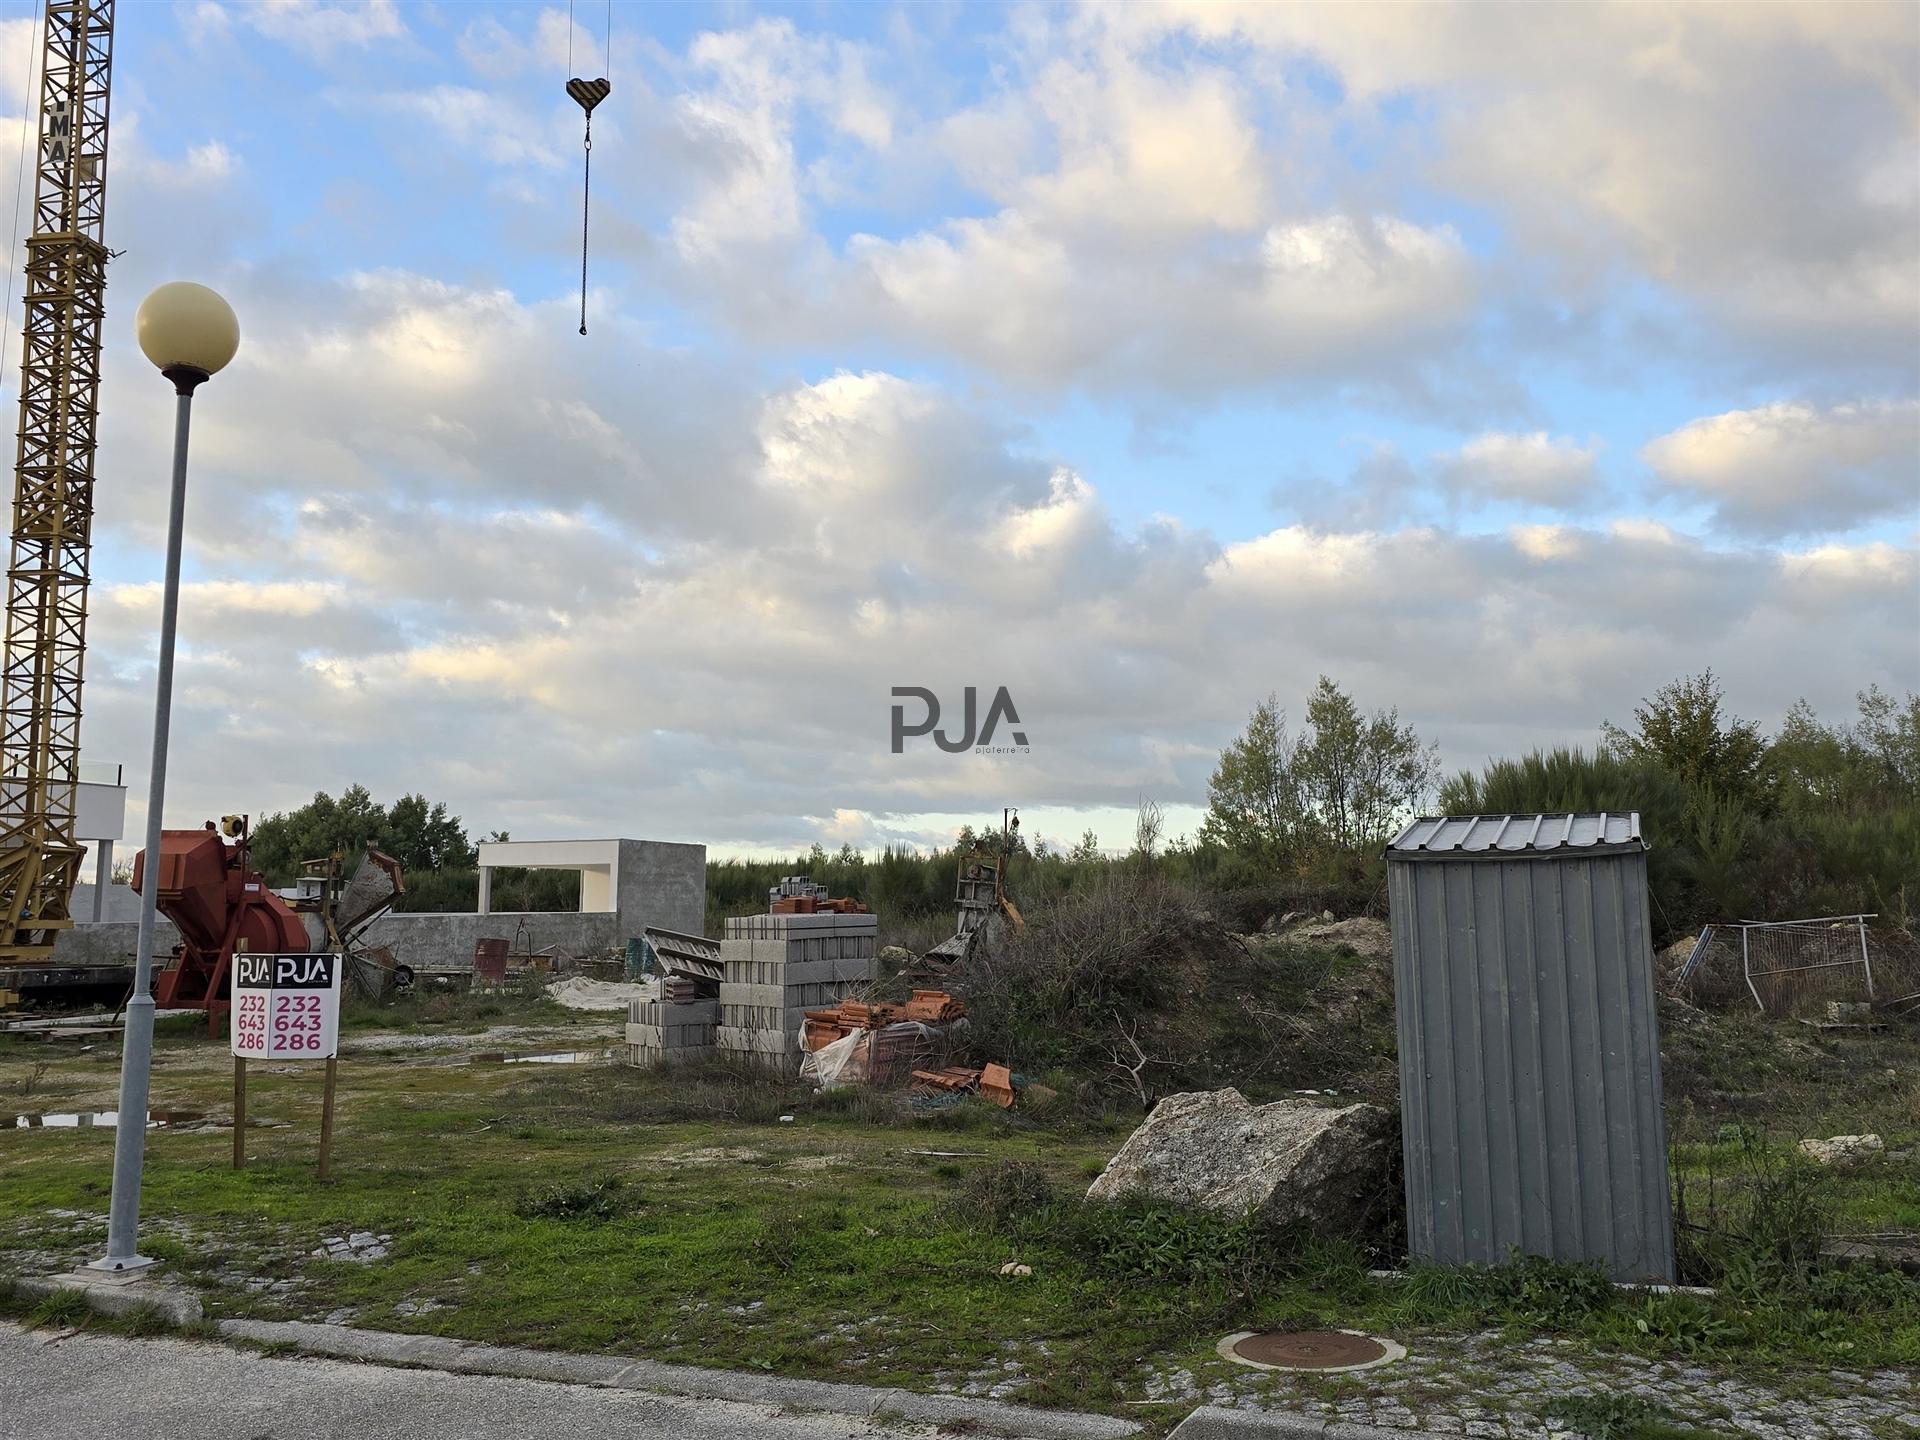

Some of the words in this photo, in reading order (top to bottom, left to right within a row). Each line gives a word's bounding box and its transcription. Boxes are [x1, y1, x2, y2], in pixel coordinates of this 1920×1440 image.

[239, 958, 270, 983] PJA
[276, 958, 329, 984] PJA
[240, 995, 265, 1012] 232
[276, 996, 321, 1012] 232
[238, 1014, 265, 1031] 643
[274, 1015, 321, 1031] 643
[238, 1033, 264, 1050] 286
[273, 1034, 321, 1050] 286
